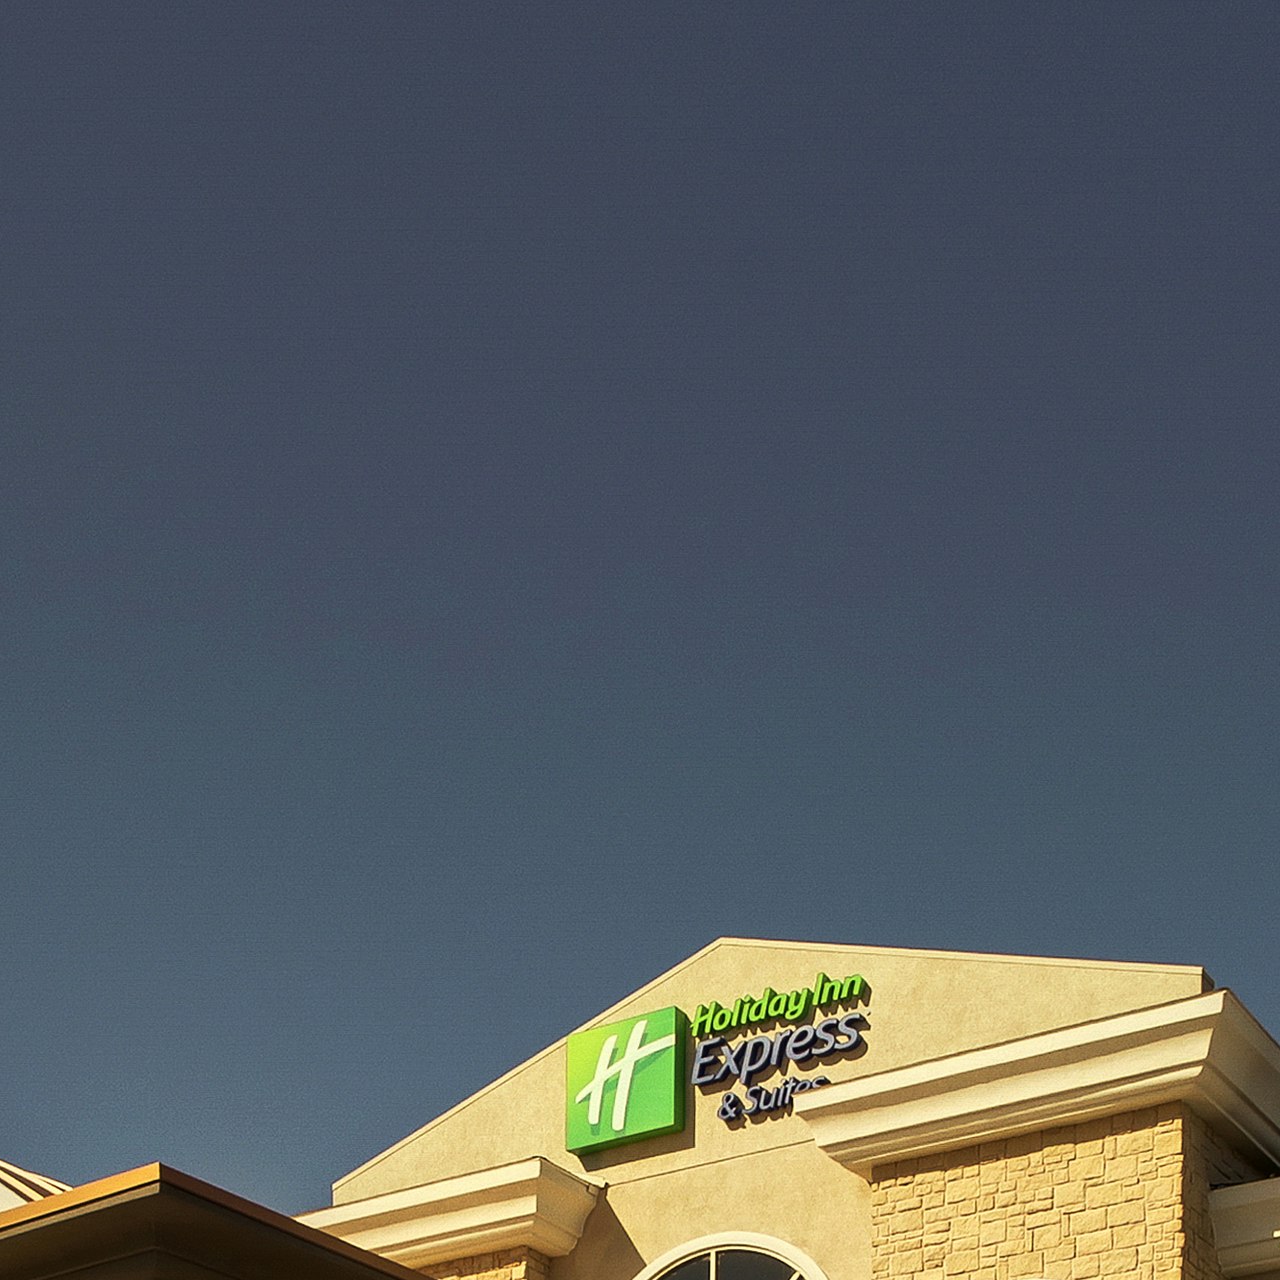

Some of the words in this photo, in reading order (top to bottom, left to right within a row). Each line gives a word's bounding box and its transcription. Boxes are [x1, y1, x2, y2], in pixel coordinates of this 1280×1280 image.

[690, 987, 810, 1037] Holiday
[812, 971, 866, 1007] Inn
[690, 1012, 864, 1086] Express
[718, 1091, 738, 1120] &
